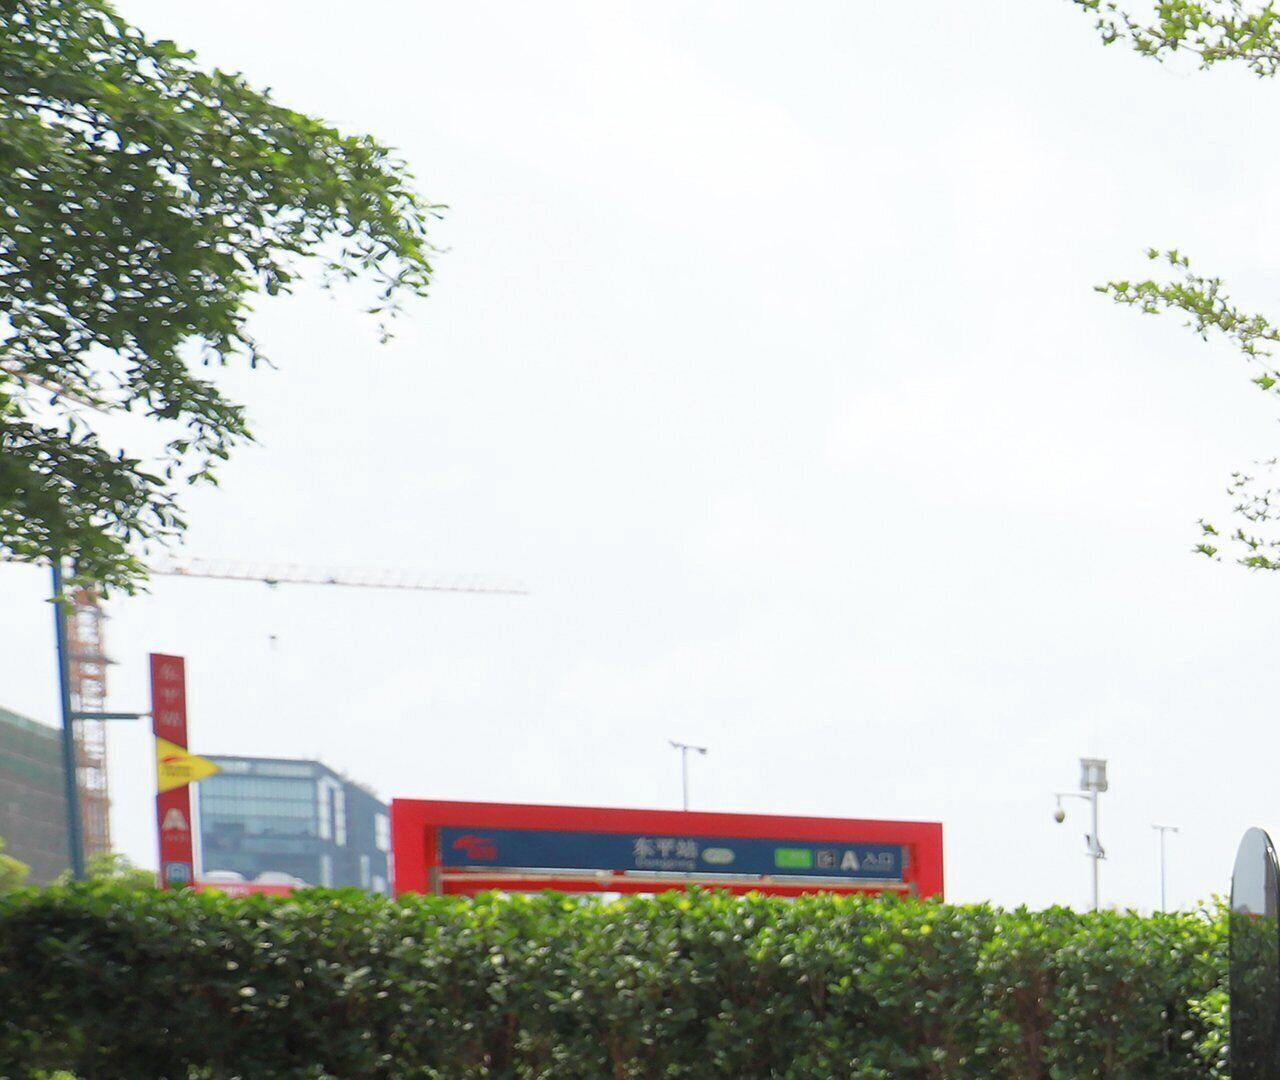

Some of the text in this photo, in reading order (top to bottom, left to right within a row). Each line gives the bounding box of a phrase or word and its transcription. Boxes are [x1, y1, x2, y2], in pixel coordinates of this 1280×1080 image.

[162, 808, 188, 831] A
[632, 837, 698, 859] 东平站
[840, 850, 860, 871] A
